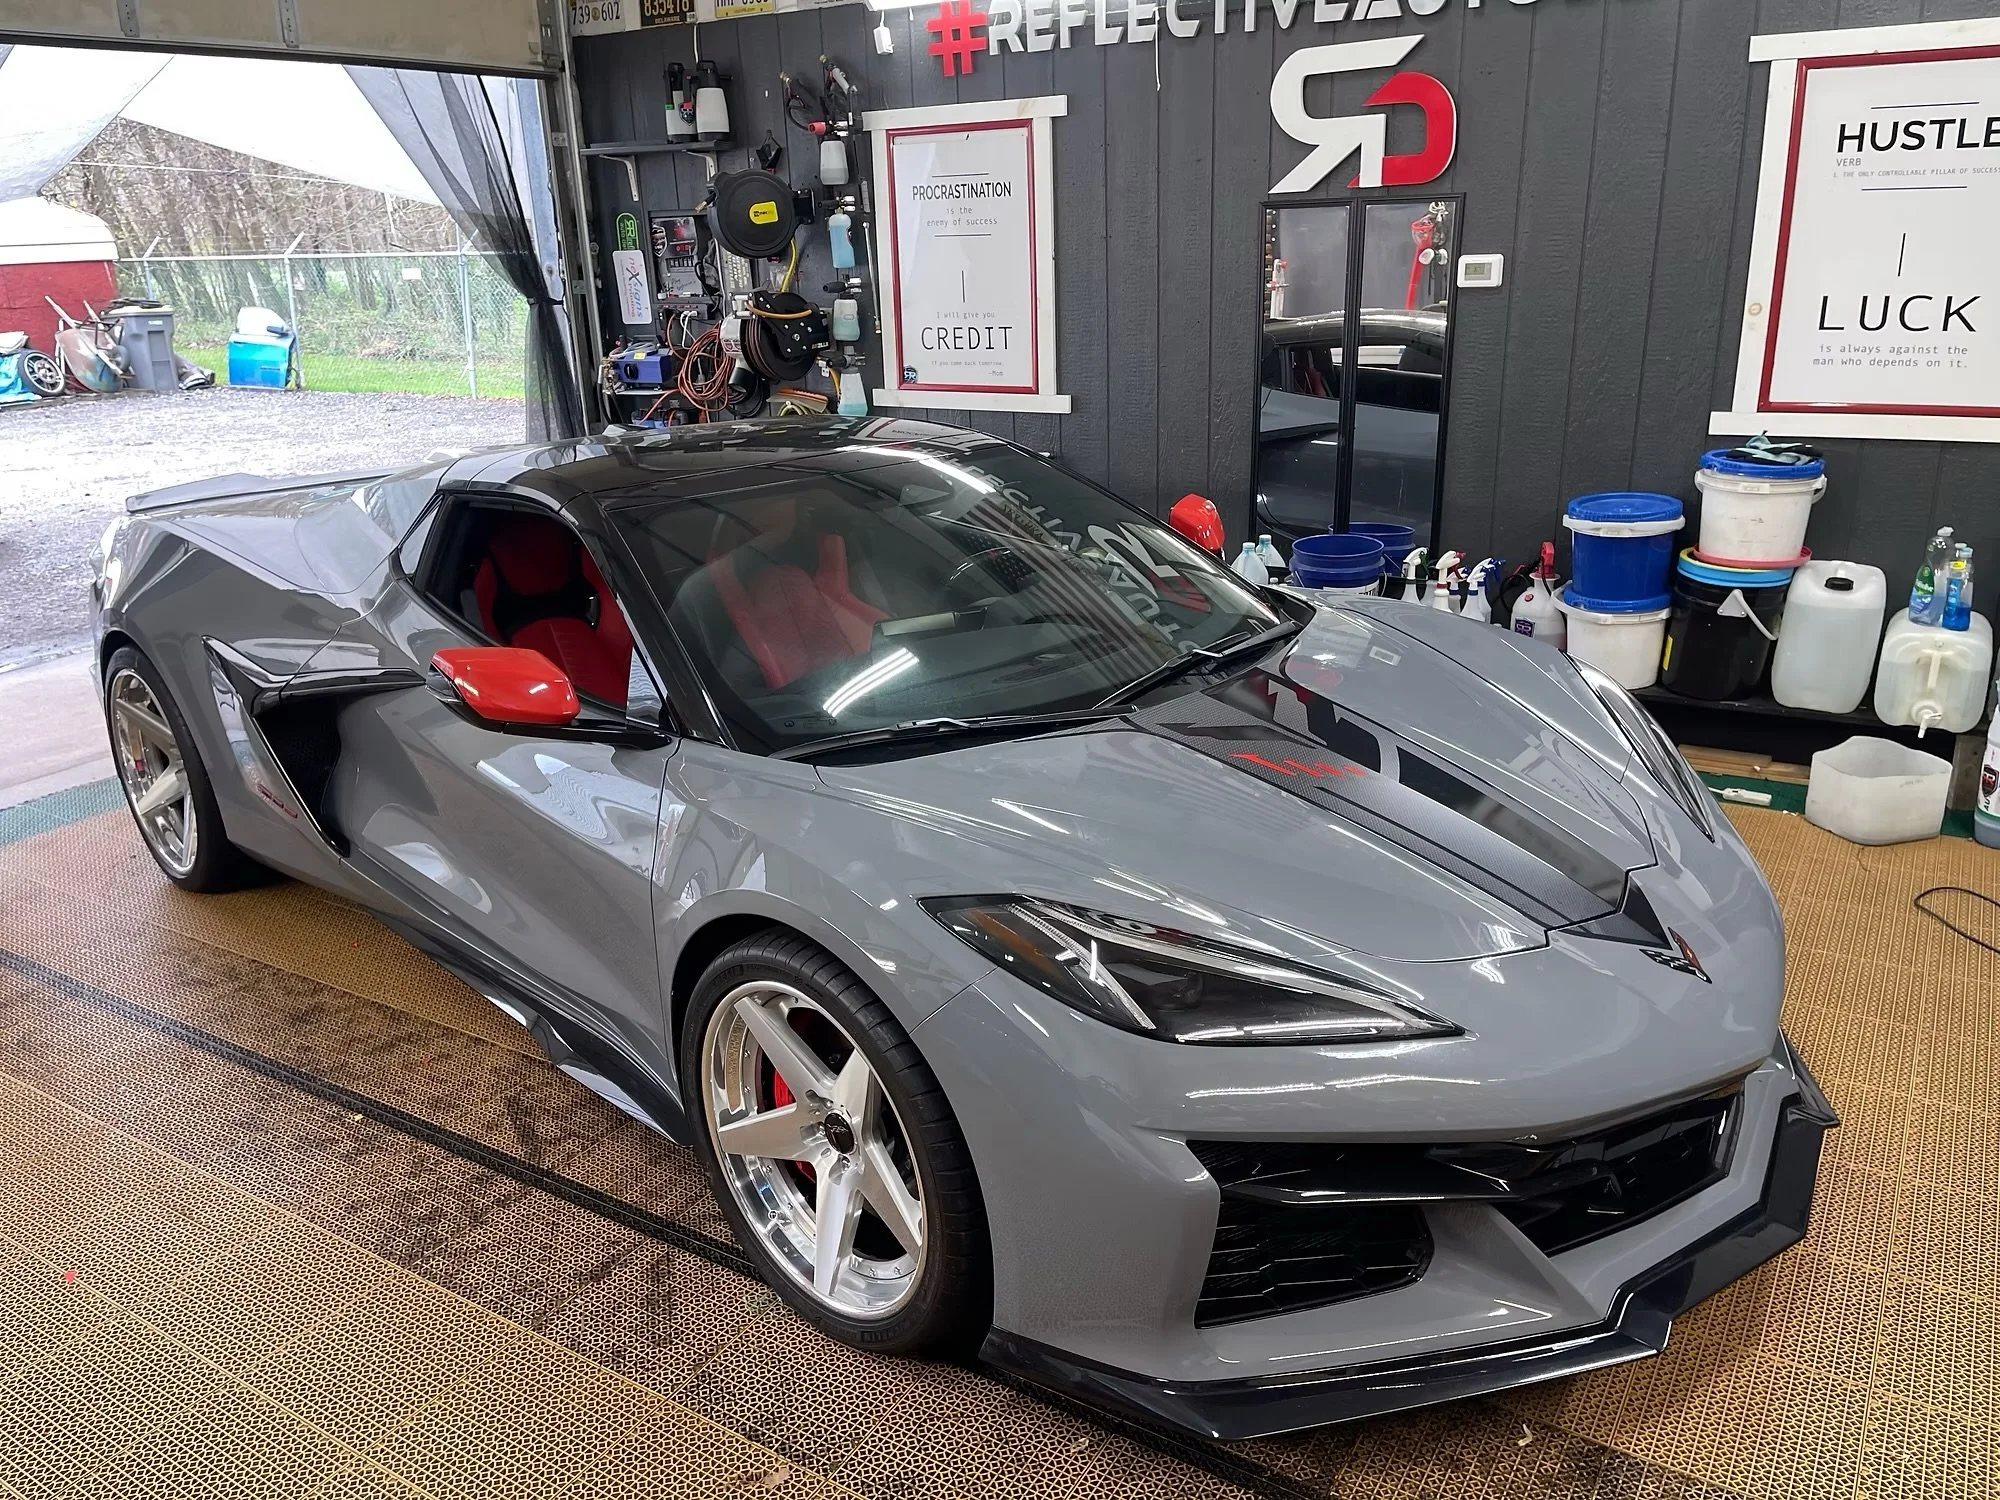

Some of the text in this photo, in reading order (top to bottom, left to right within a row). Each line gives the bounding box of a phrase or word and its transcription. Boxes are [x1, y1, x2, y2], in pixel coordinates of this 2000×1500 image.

[571, 1, 620, 25] 739 602
[1836, 116, 2000, 153] HUSTLE
[1836, 157, 1862, 167] VERB
[1877, 168, 1926, 177] CONTROLLABLE
[1930, 167, 1956, 175] PILLAR
[912, 181, 1012, 200] PROCRASTINATION
[946, 206, 973, 215] is the
[926, 217, 998, 228] enemy of success
[944, 311, 960, 319] will
[963, 311, 979, 320] give
[982, 312, 995, 320] you
[1818, 294, 1982, 332] LUCK
[921, 326, 1013, 350] CREDIT
[1820, 344, 1968, 356] is always against the
[1812, 357, 1968, 369] man who depends on it.
